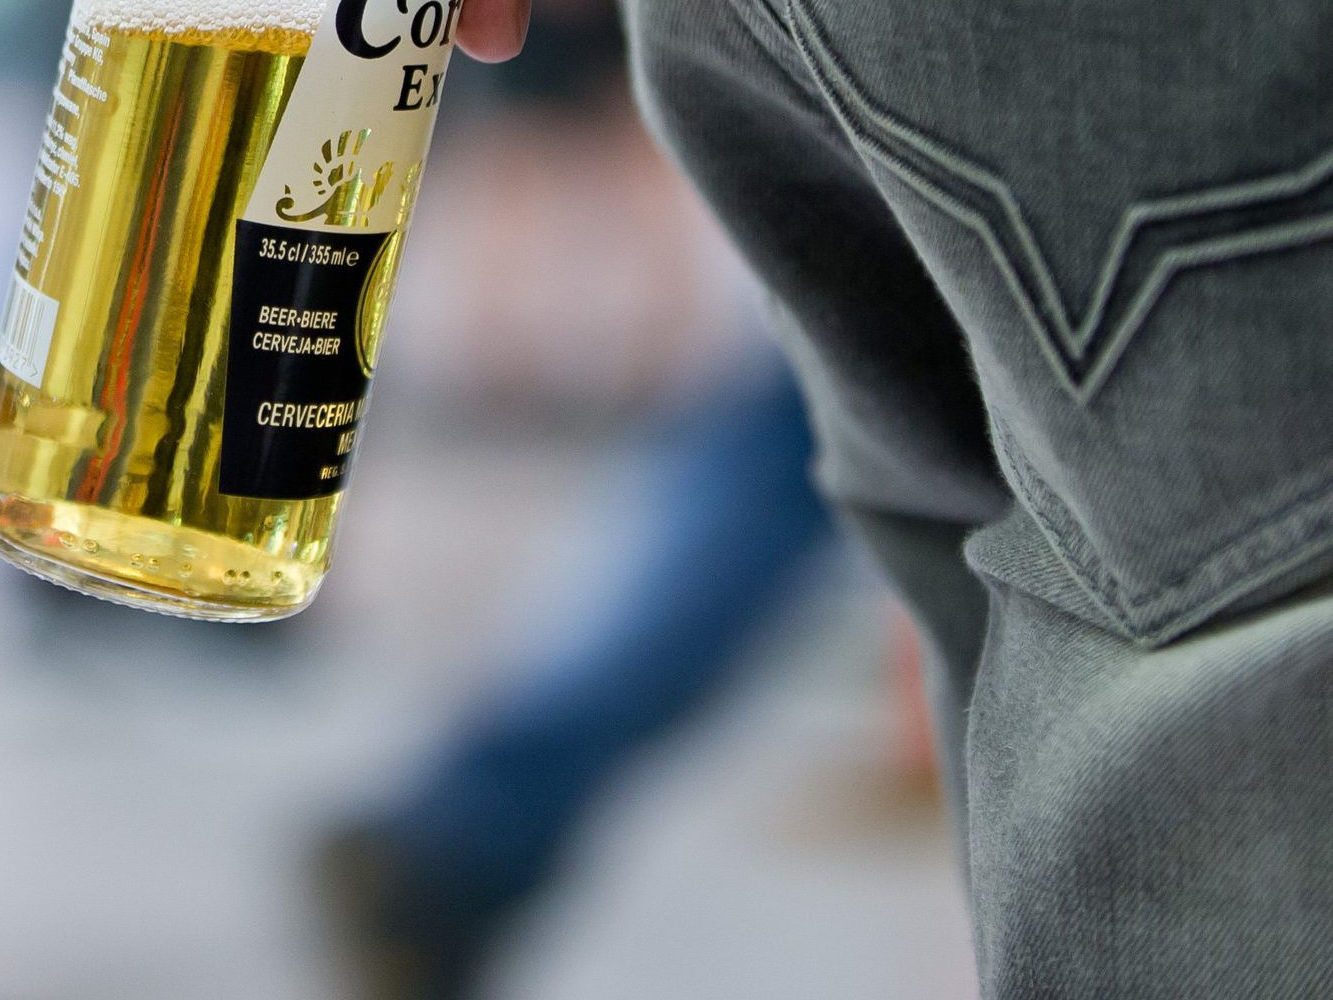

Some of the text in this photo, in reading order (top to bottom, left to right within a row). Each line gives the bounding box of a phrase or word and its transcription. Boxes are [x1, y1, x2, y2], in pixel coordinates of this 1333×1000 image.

[393, 64, 444, 111] Ex
[259, 238, 287, 260] 35.5
[288, 243, 301, 262] cl
[309, 245, 331, 265] 355
[257, 401, 354, 428] CERVECERIA
